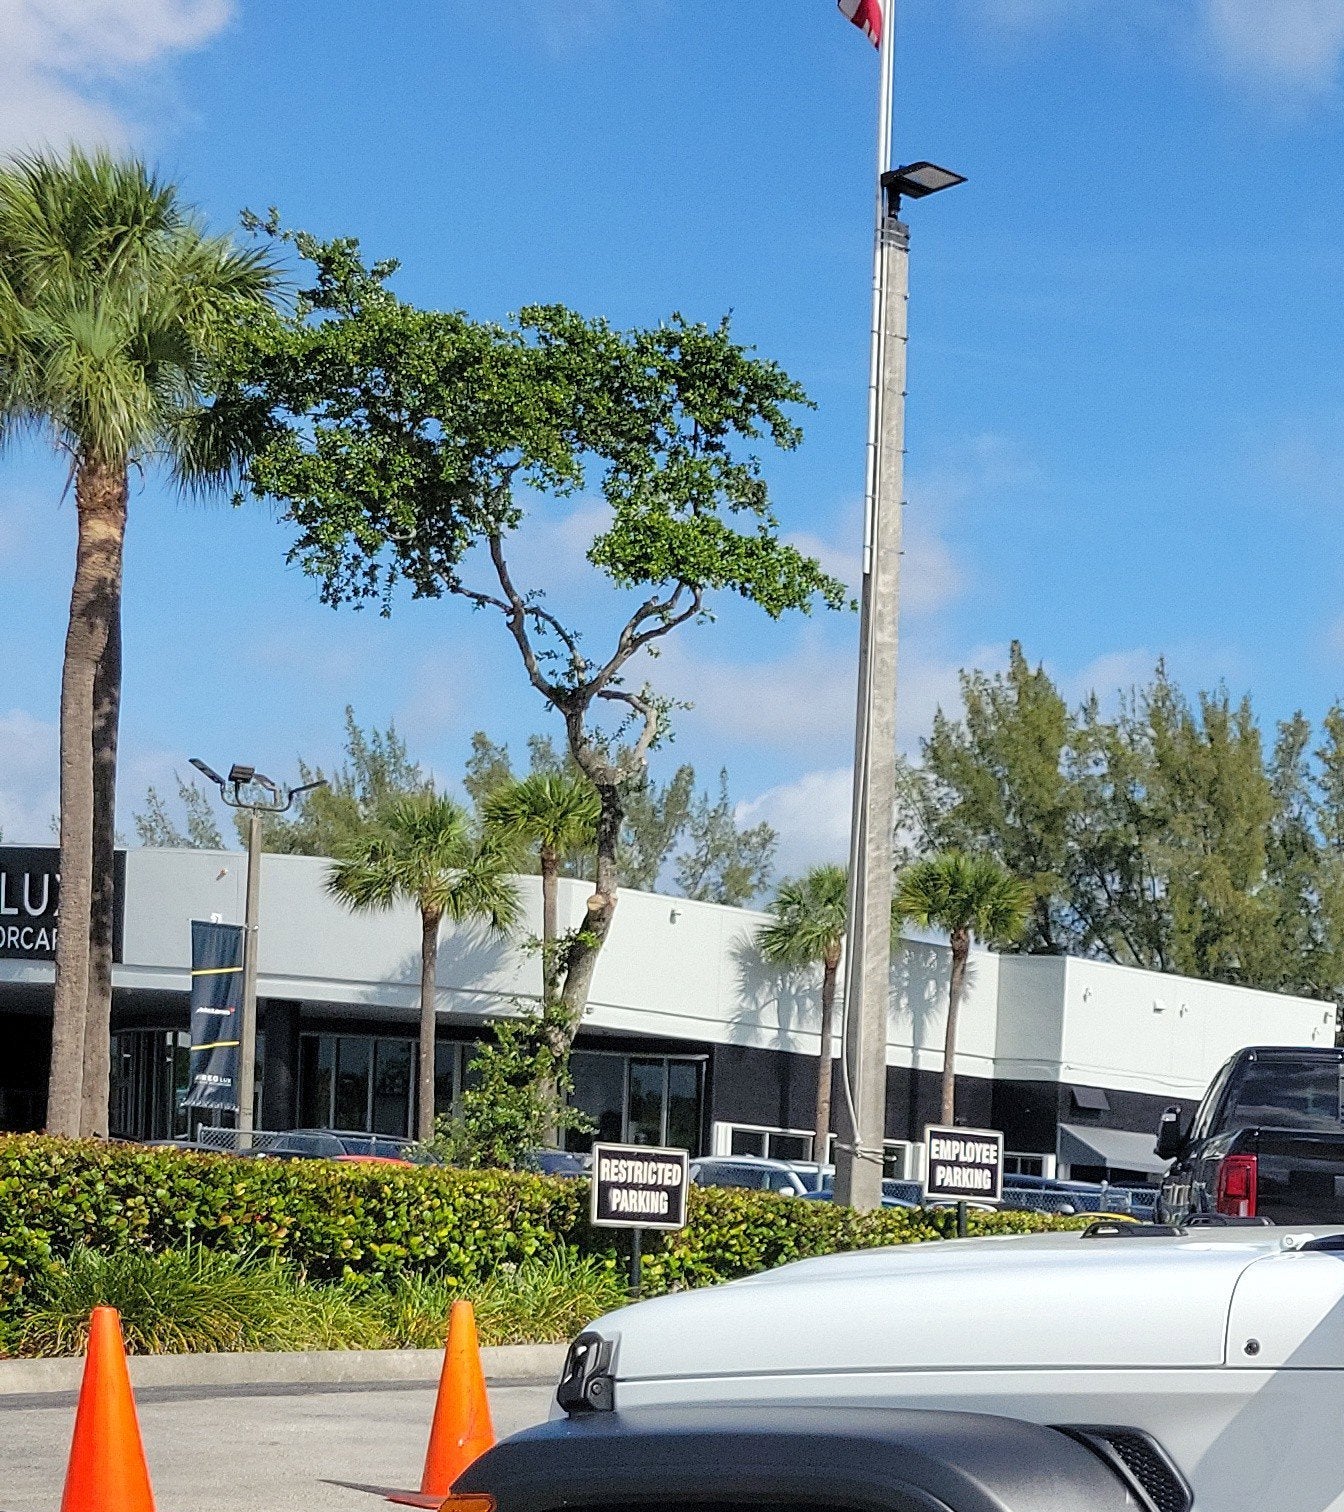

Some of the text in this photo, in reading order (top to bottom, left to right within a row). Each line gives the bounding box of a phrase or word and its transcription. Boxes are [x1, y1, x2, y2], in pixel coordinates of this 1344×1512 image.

[0, 872, 60, 916] LU
[931, 1138, 998, 1165] EMPLOYEE
[600, 1158, 682, 1187] RESTRICTED
[936, 1165, 992, 1189] PARKING
[609, 1187, 669, 1215] PARKING
